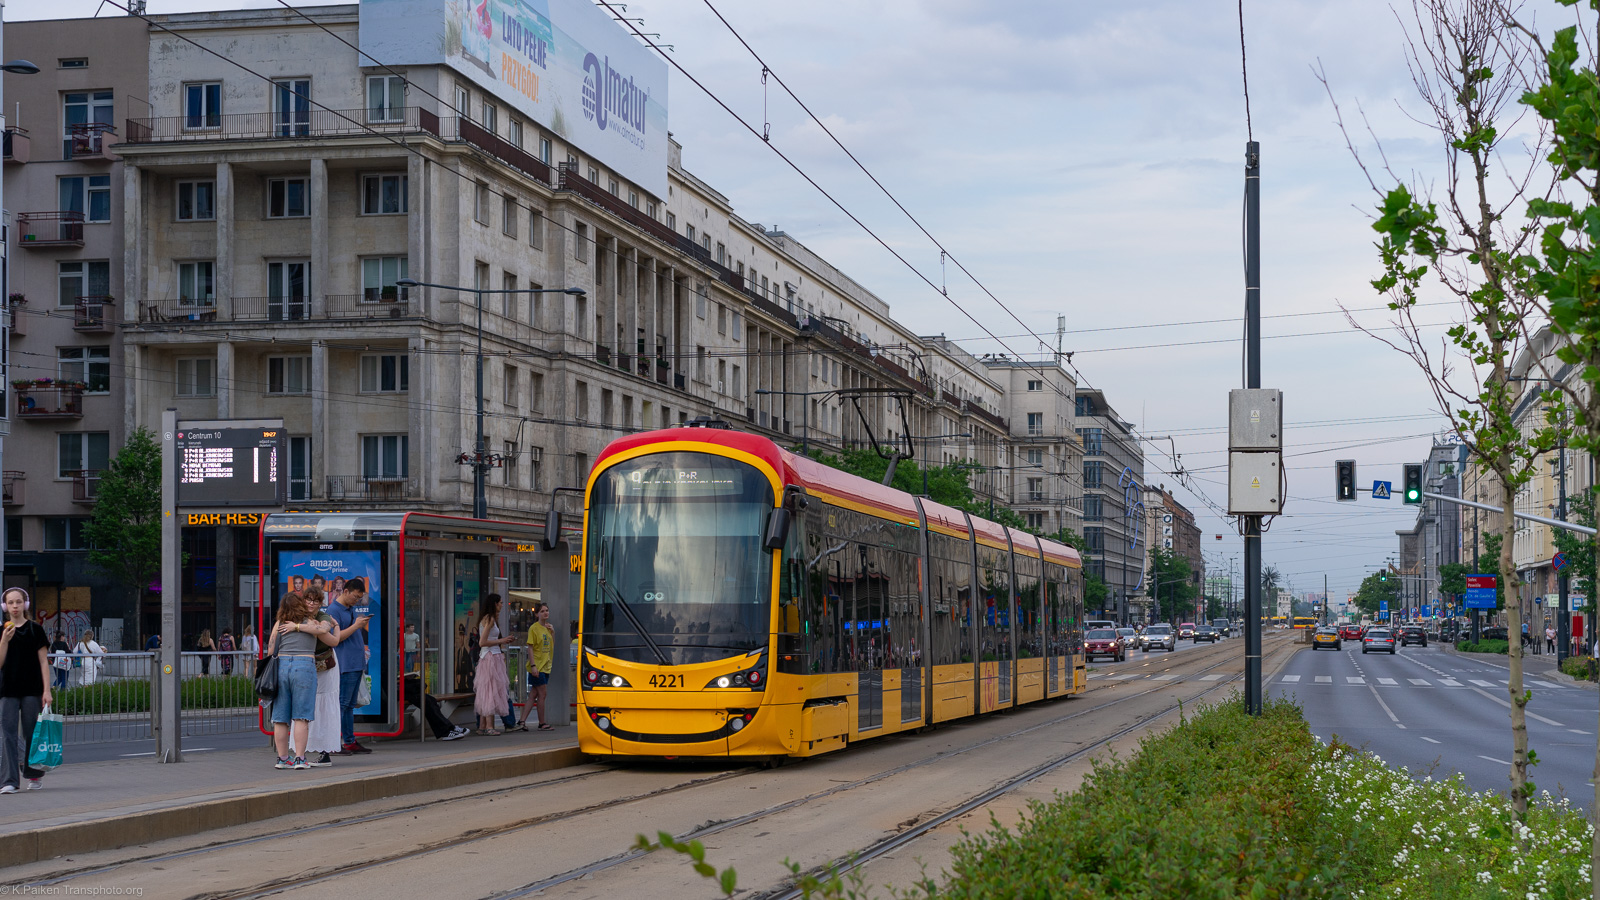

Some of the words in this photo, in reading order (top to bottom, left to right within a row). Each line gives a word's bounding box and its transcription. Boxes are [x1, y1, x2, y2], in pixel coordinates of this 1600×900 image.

[502, 11, 522, 52] LATO
[524, 26, 547, 71] PEŁNE
[501, 51, 540, 105] PRZYGÓD!
[214, 431, 221, 439] 10
[679, 471, 698, 480] P+R
[188, 513, 221, 525] BAR
[1163, 514, 1172, 548] Orb
[309, 559, 343, 567] amazon
[649, 674, 685, 688] 4221
